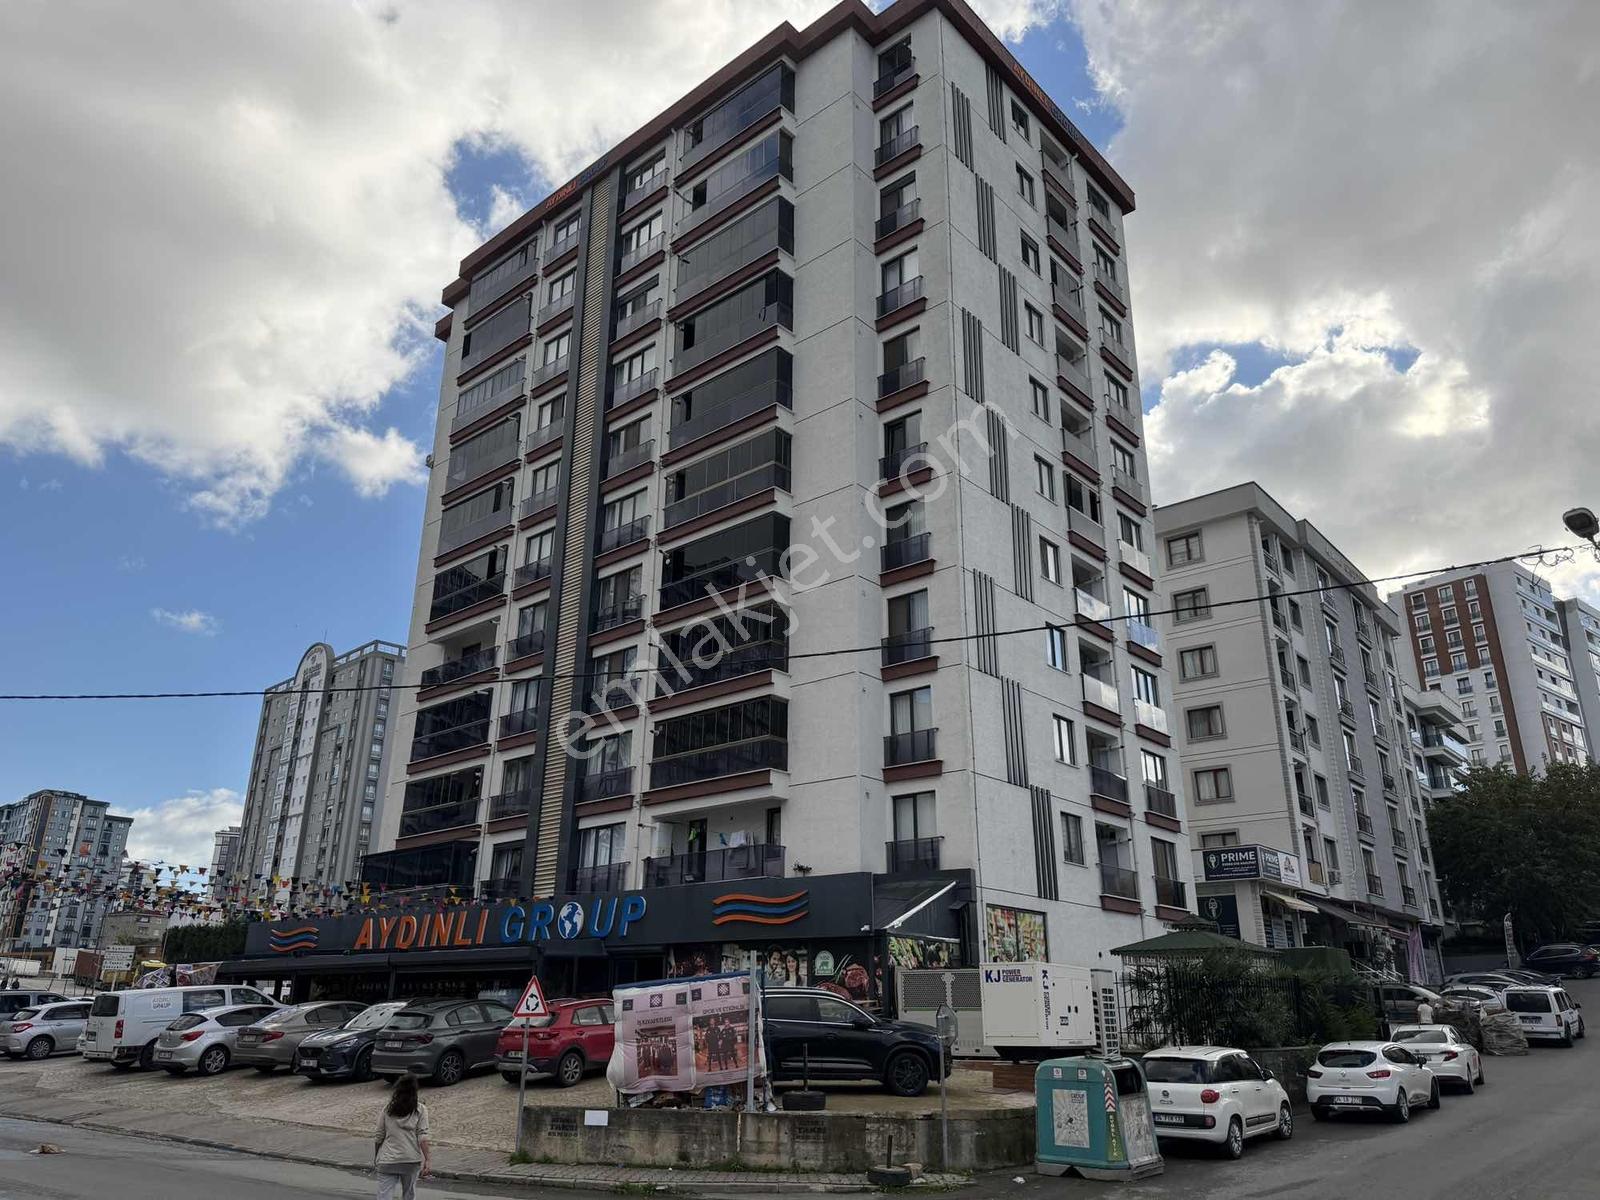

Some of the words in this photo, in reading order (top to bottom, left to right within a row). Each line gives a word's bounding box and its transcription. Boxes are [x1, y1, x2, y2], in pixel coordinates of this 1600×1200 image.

[1221, 851, 1256, 862] PRIME
[354, 908, 490, 950] AYDINLI
[500, 895, 647, 943] GROUP
[985, 969, 1001, 983] KJ
[1002, 975, 1033, 983] GENERATOR
